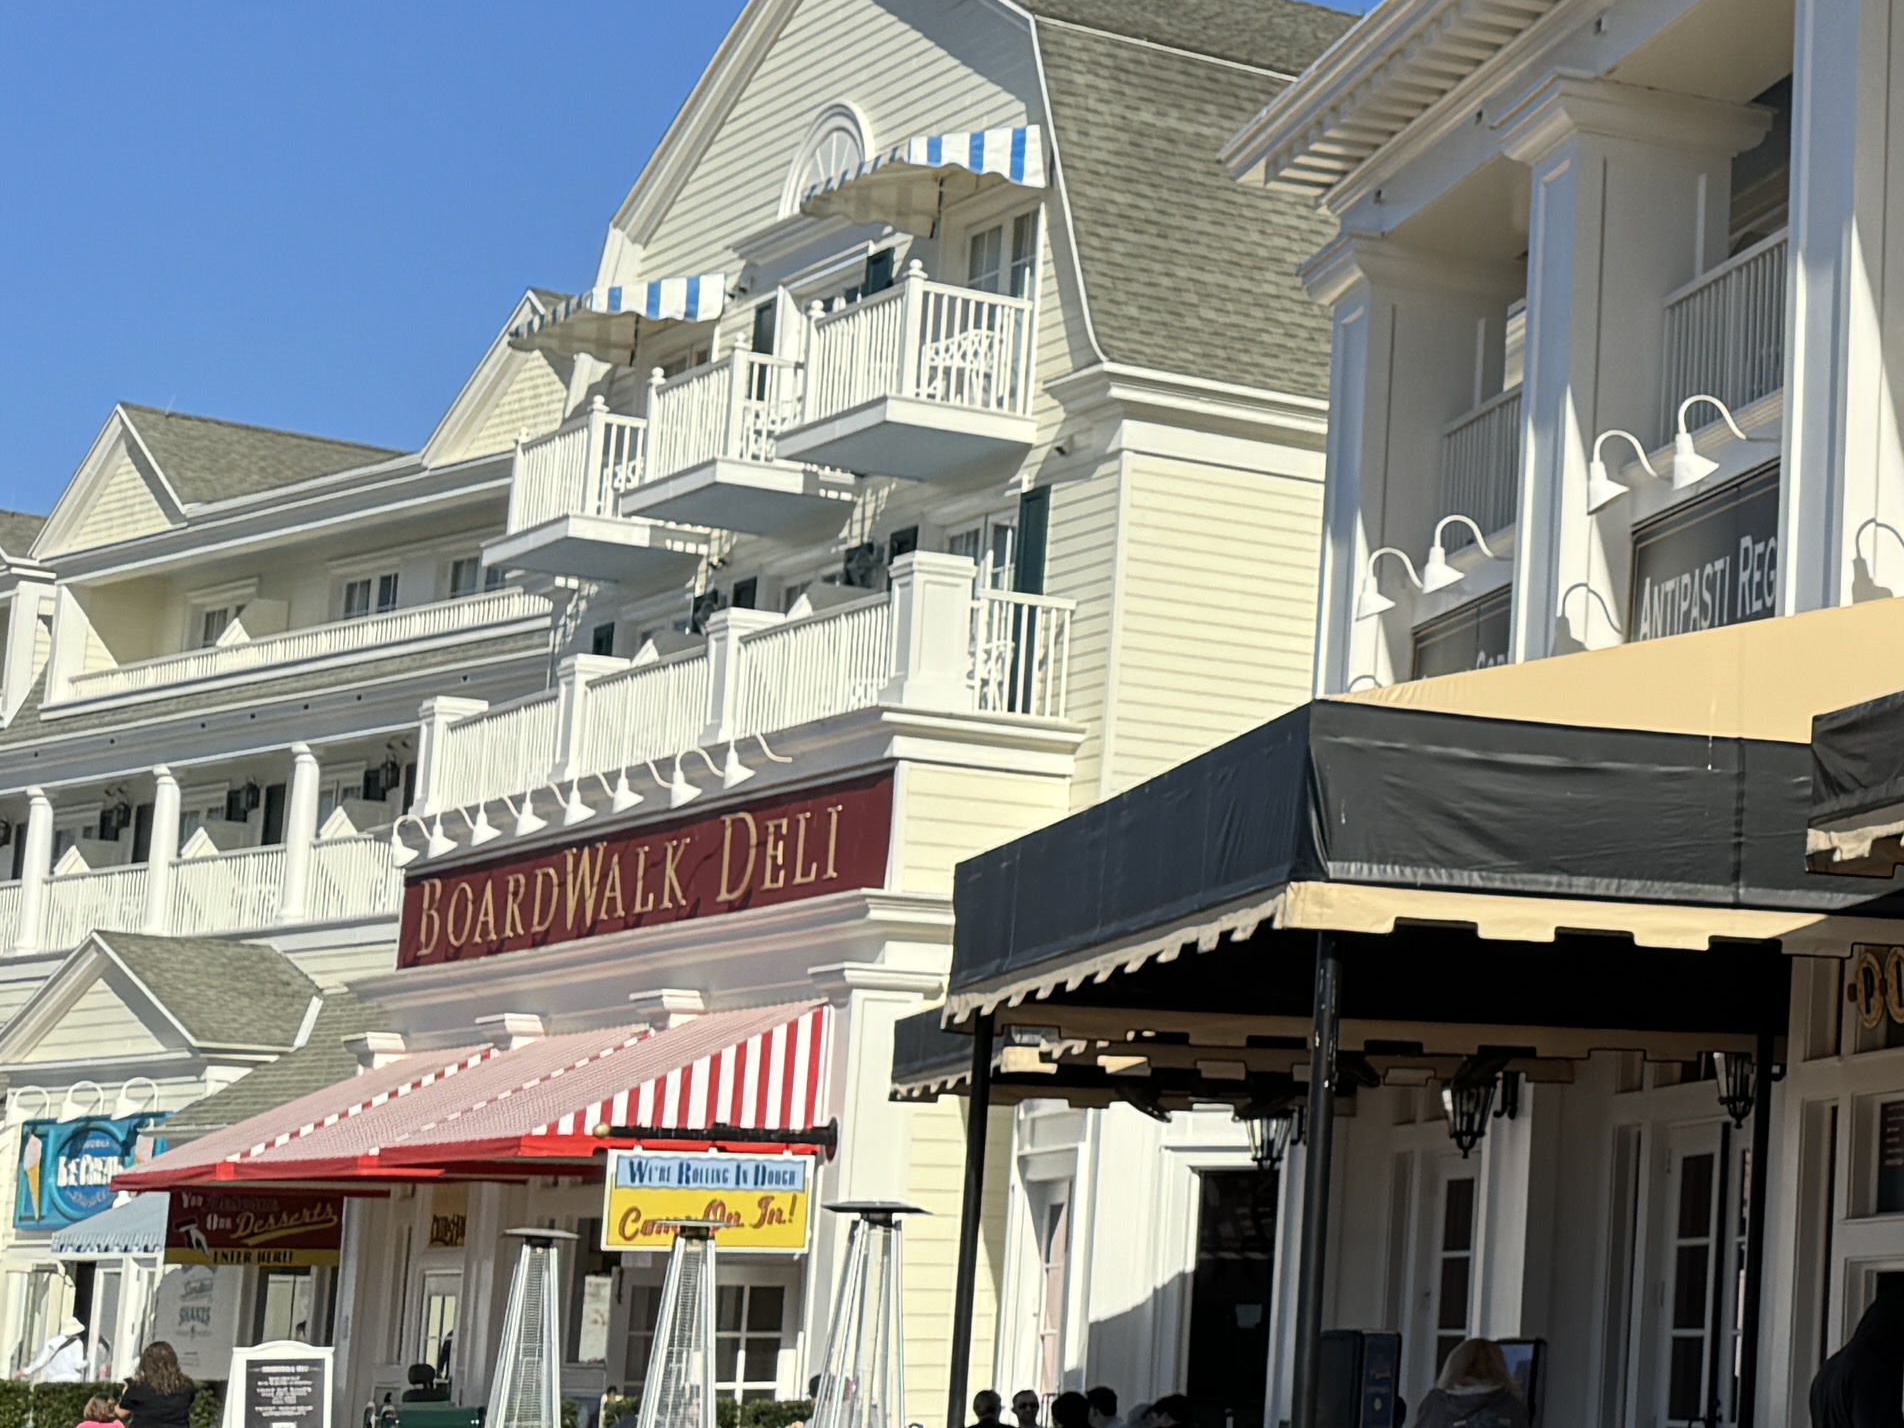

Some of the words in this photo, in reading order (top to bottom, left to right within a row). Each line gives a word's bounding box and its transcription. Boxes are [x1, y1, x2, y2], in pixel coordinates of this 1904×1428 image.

[1639, 555, 1730, 642] ANTIPASTI
[416, 837, 692, 957] BOARDWALK
[715, 804, 844, 904] DELI
[677, 1160, 729, 1185] ROLLING
[734, 1162, 748, 1187] IN
[753, 1163, 797, 1187] DOUGH
[230, 1202, 338, 1239] Desserts
[749, 1193, 798, 1229] In!
